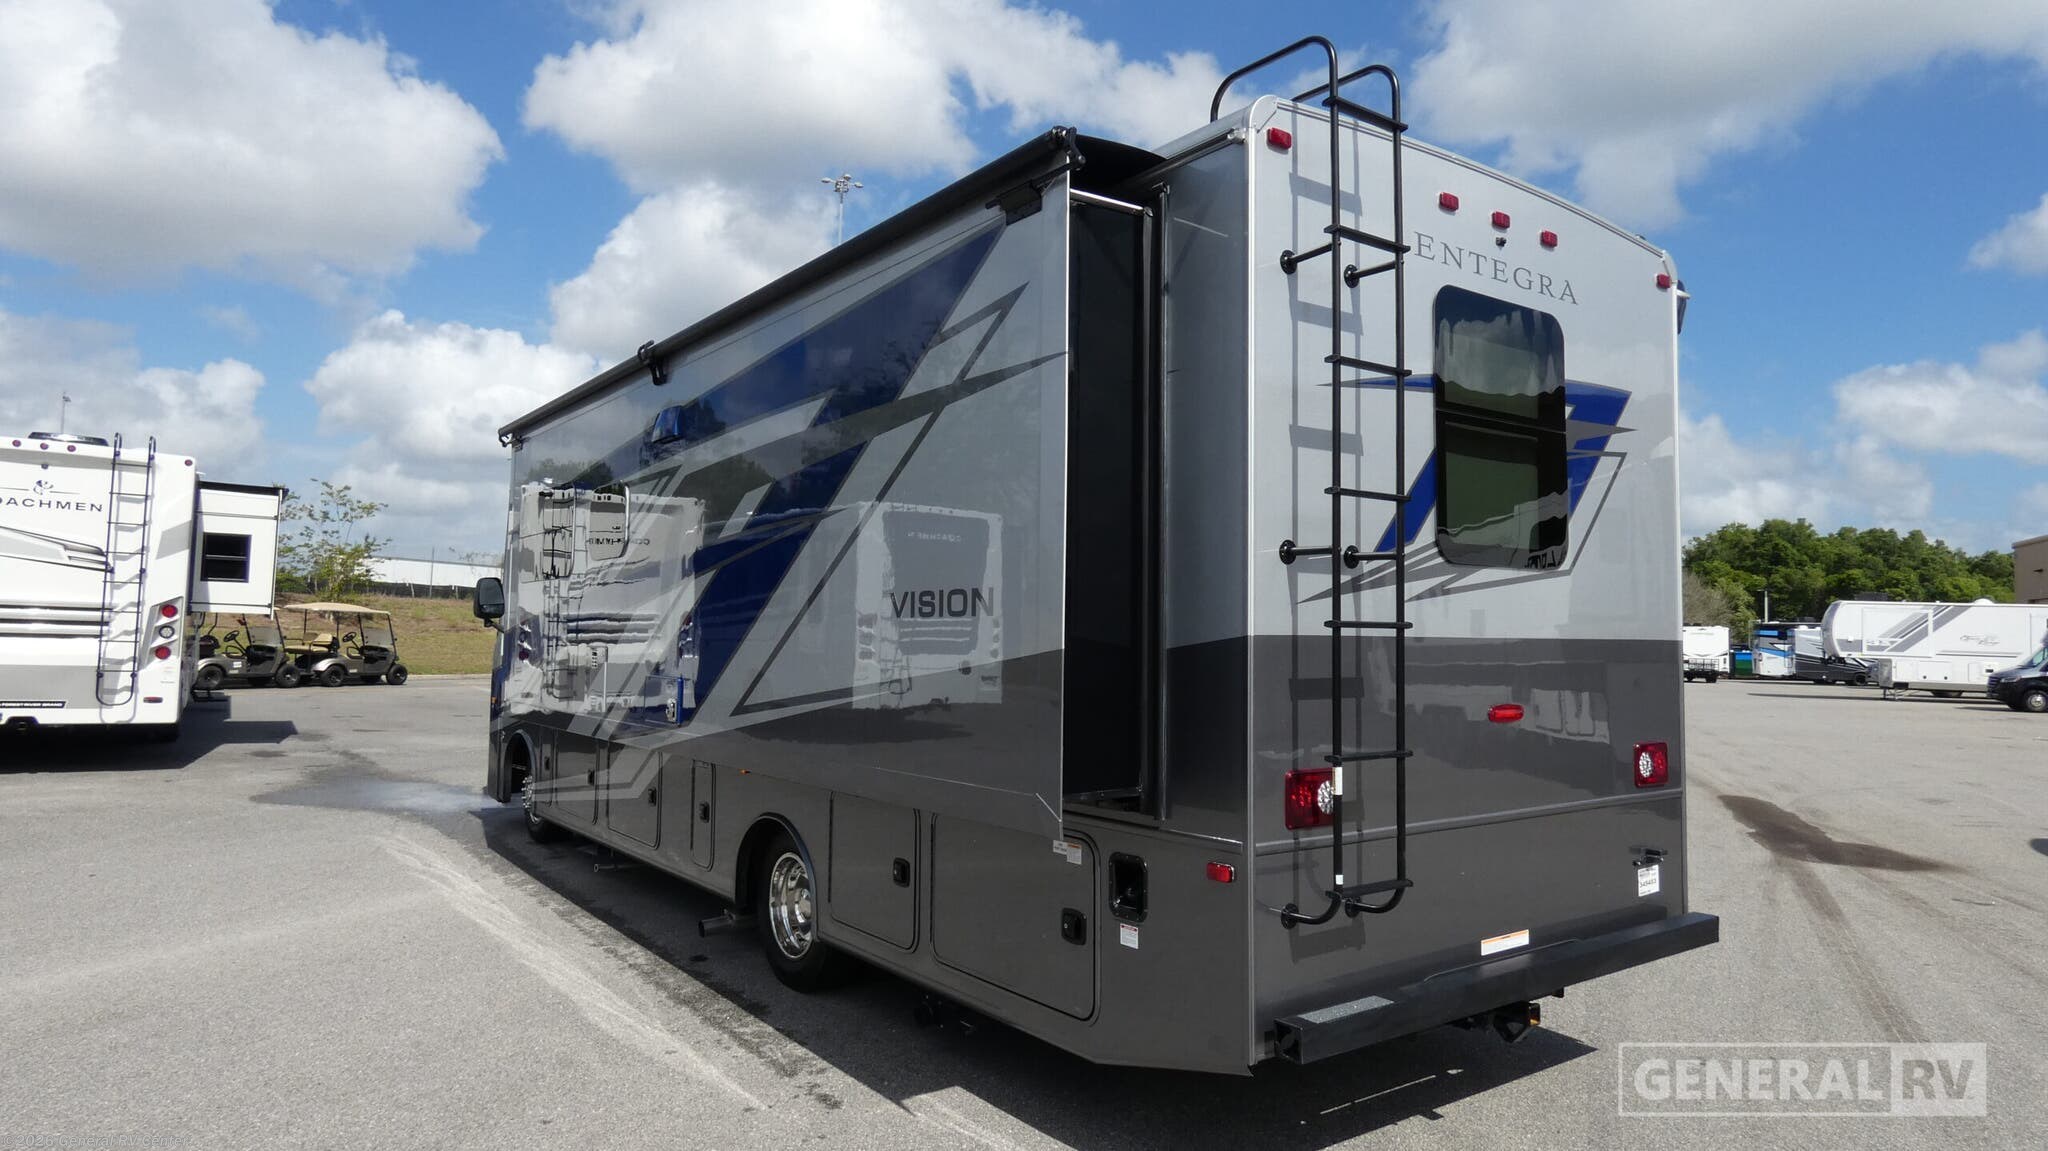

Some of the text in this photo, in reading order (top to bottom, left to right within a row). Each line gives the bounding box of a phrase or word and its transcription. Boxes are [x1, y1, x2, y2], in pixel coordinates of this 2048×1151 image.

[1414, 231, 1579, 305] ENTEGRA
[0, 496, 103, 513] ACHMEN
[890, 586, 995, 619] VISION
